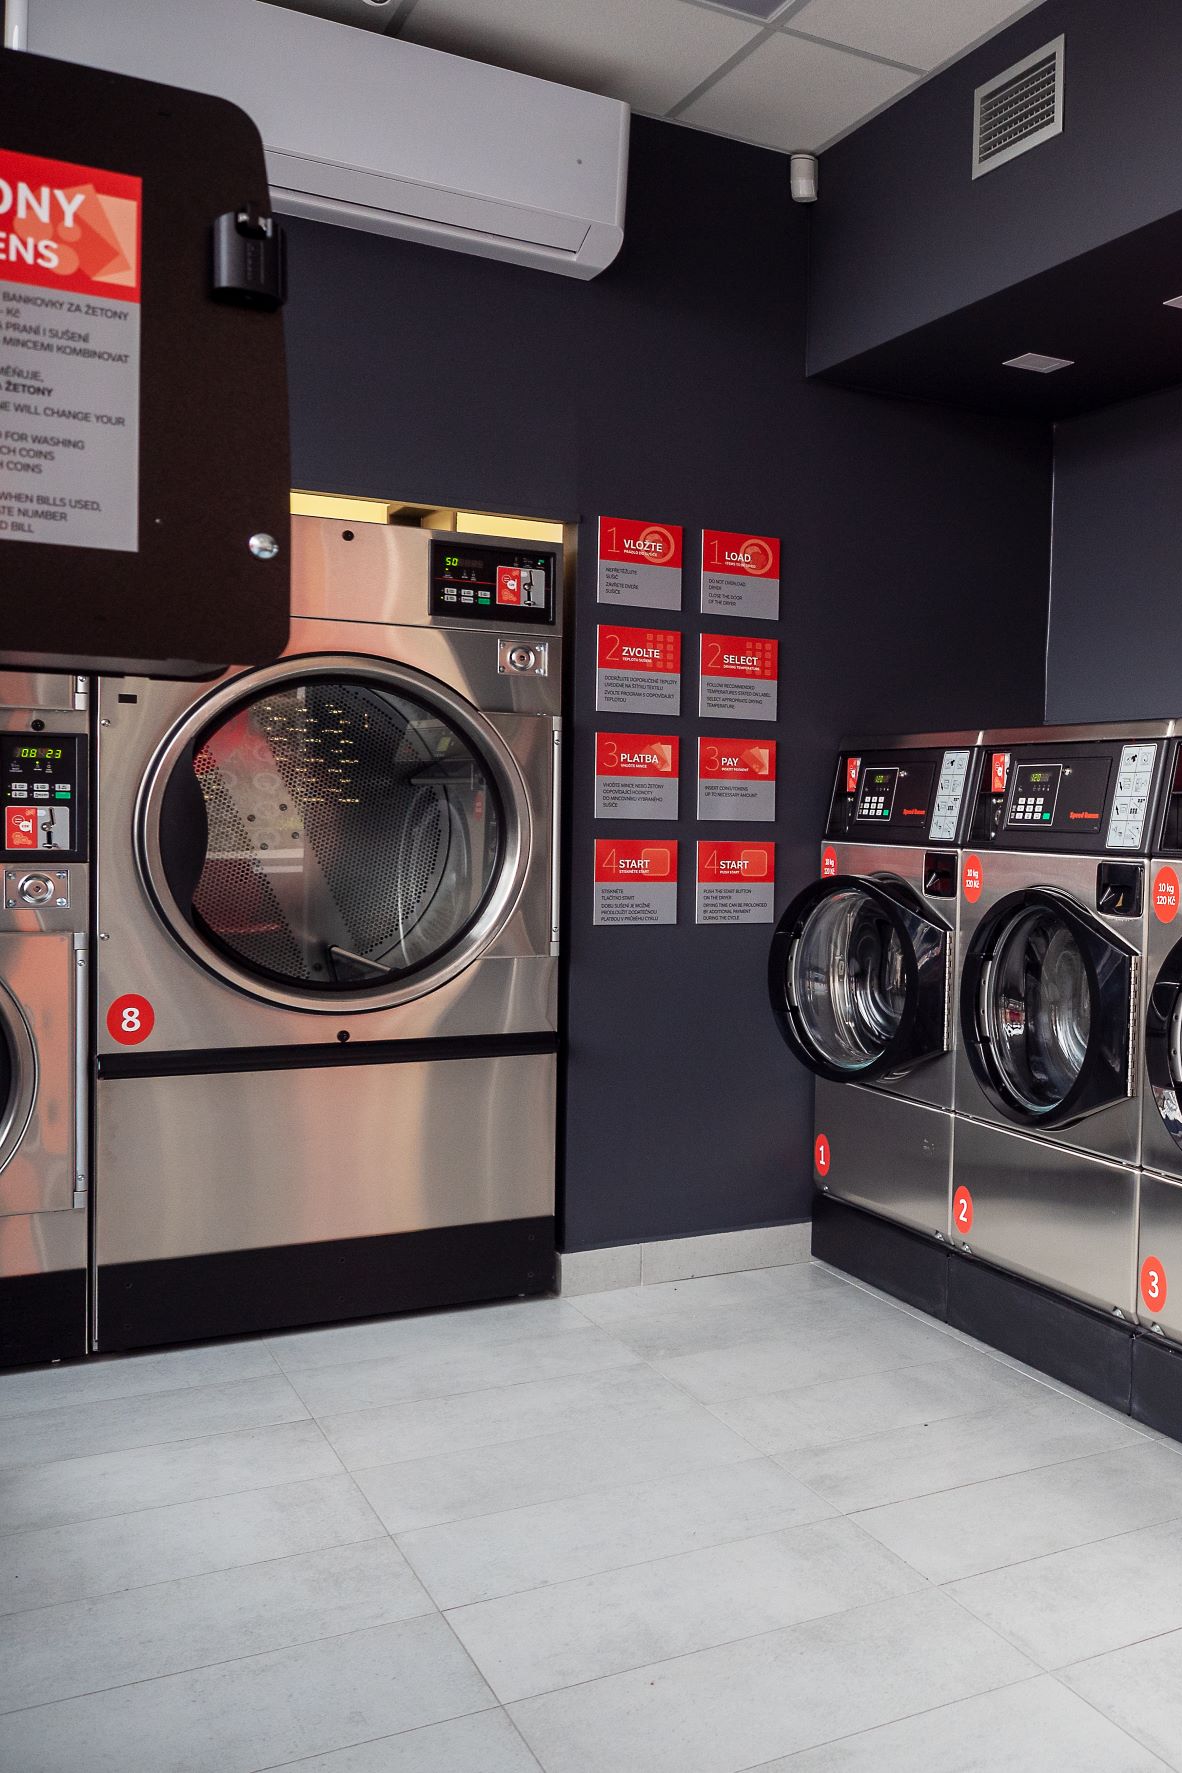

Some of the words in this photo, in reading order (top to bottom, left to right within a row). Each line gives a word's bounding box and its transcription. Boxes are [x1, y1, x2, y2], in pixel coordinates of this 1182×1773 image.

[2, 291, 64, 310] BANKOVKY
[67, 302, 82, 313] ZA
[85, 304, 129, 320] ŽETONY
[5, 322, 40, 336] PRANÍ
[48, 328, 90, 343] SUŠENÍ
[2, 336, 54, 352] MINCEMI
[56, 344, 130, 363] KOMBINOVAT
[5, 381, 53, 397] ŽETONY
[13, 403, 40, 415] WILL
[43, 407, 91, 422] CHANGE
[94, 414, 125, 426] YOUR
[5, 431, 28, 442] FOR
[30, 434, 85, 450] WASHING
[19, 447, 55, 460] COINS
[6, 461, 42, 474] COINS
[36, 495, 66, 507] BILLS
[17, 508, 68, 521] NUMBER
[11, 522, 34, 533] BILL
[608, 527, 620, 552] 1
[624, 539, 663, 552] VLOŽTE
[710, 540, 722, 565] 1
[725, 552, 751, 562] LOAD
[445, 557, 458, 566] 50
[606, 635, 619, 661] 2
[622, 647, 660, 658] ZVOLTE
[708, 643, 720, 668] 2
[723, 655, 758, 665] SELECT
[603, 742, 618, 767] 3
[620, 753, 658, 764] PLATBA
[706, 746, 719, 771] 3
[722, 758, 738, 766] PAY
[603, 848, 618, 874] 4
[619, 860, 650, 868] START
[705, 849, 719, 875] 4
[720, 861, 749, 869] START
[1158, 883, 1166, 892] 10
[1167, 883, 1174, 894] kg
[1157, 896, 1166, 904] 120
[121, 1008, 140, 1032] 8
[820, 1145, 825, 1165] 1
[960, 1199, 968, 1222] 2
[1148, 1271, 1158, 1298] 3
